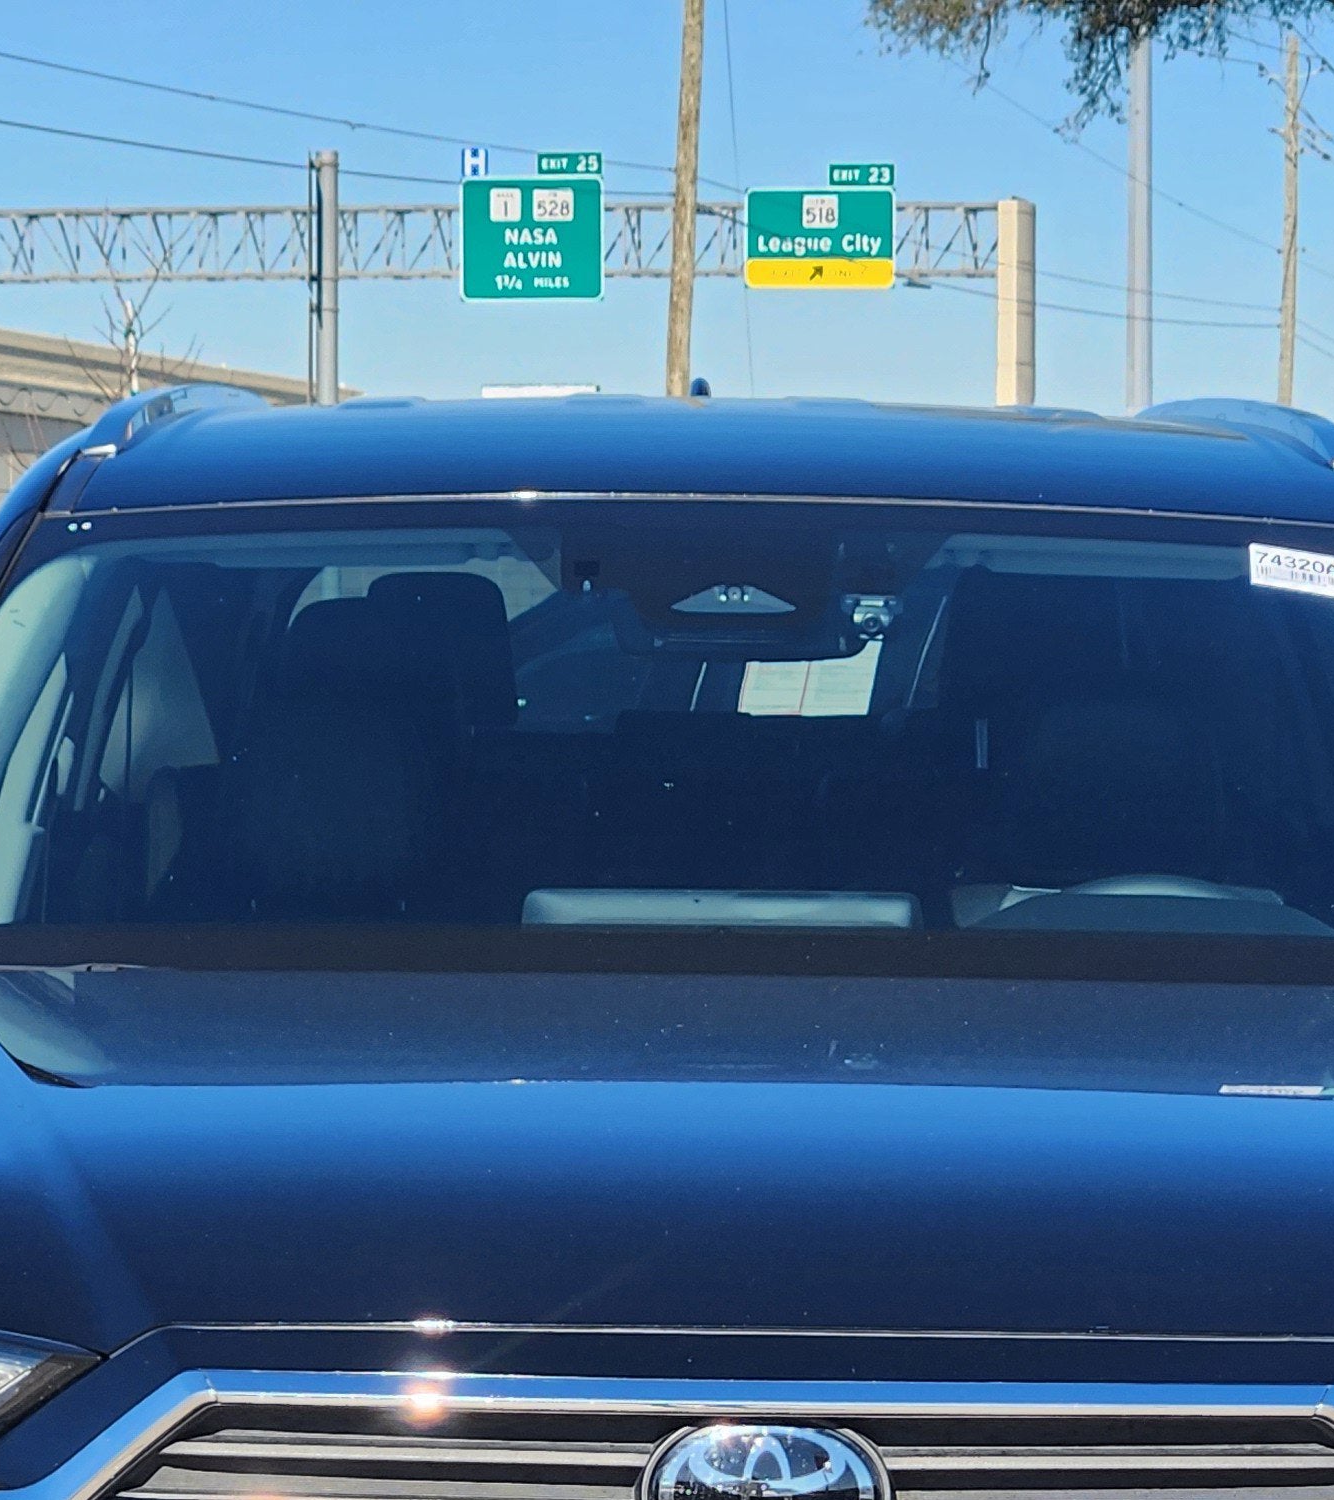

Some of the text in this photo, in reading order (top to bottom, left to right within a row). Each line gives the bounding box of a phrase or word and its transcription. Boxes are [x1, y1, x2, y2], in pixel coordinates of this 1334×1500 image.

[541, 155, 599, 172] EXIT 25
[832, 167, 891, 183] EXIT 23
[537, 200, 570, 217] 528
[805, 207, 836, 224] 518
[504, 227, 558, 245] NASA
[757, 233, 882, 256] League City
[503, 251, 562, 269] ALVIN
[533, 276, 570, 289] MILES
